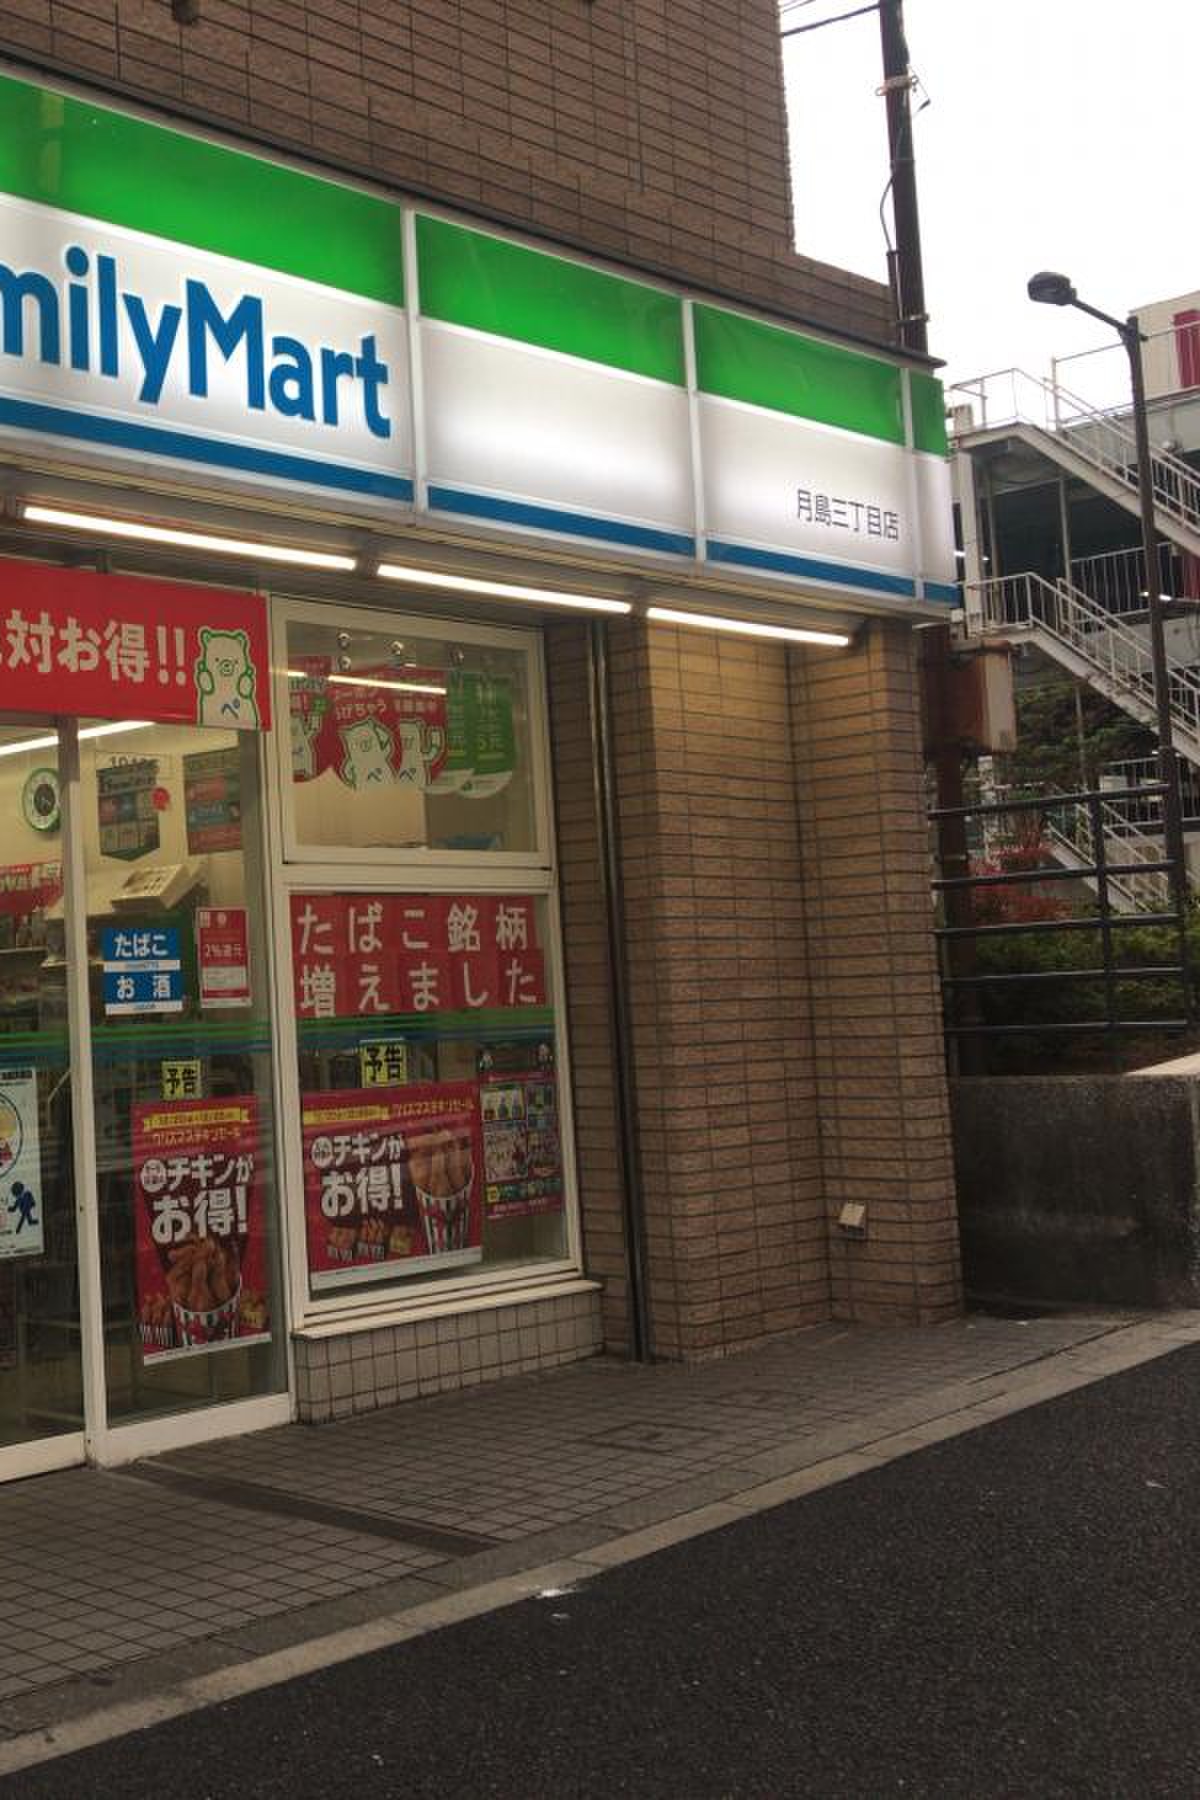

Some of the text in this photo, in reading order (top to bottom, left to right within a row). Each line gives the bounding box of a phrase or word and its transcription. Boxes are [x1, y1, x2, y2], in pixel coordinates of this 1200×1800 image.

[797, 488, 899, 540] 月島三丁目店
[113, 932, 169, 958] たばこ
[297, 901, 528, 955] たばこ銘柄
[116, 975, 171, 1000] お酒
[299, 957, 537, 1018] 増えました
[166, 1067, 196, 1094] 予告
[364, 1046, 402, 1081] 予告
[151, 1184, 248, 1245] お得!
[321, 1162, 404, 1217] お得!
